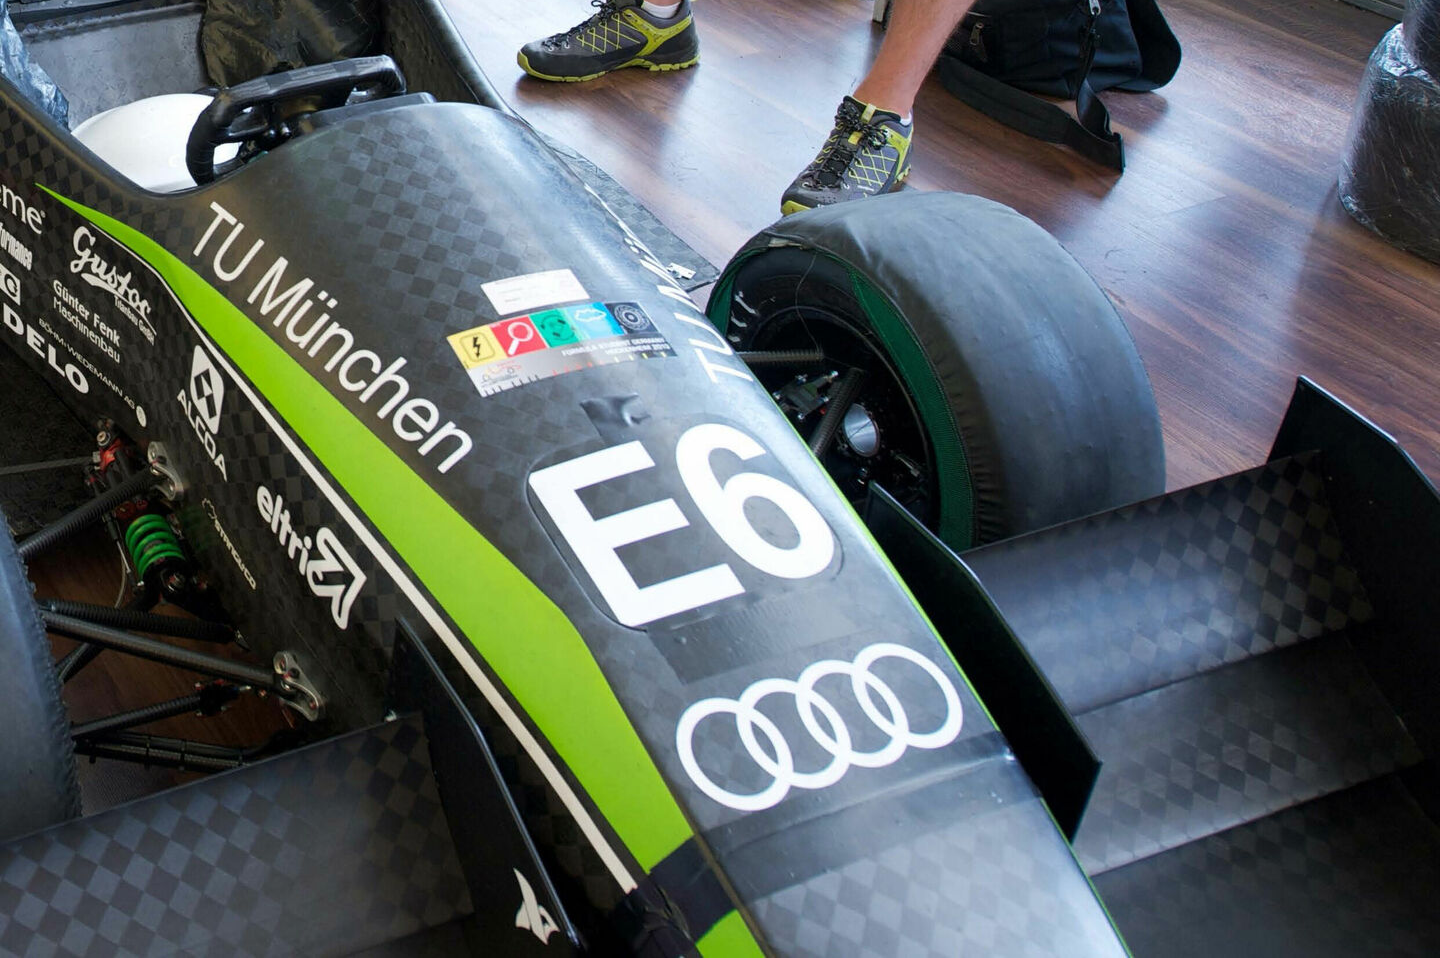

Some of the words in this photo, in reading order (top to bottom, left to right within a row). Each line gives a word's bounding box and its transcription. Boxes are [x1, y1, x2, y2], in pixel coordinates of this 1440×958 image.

[3, 302, 90, 394] DELO
[53, 280, 90, 321] Günter
[93, 312, 121, 348] Fenk
[53, 296, 120, 363] Maschinenbau
[193, 201, 265, 282] TU
[247, 256, 473, 474] München
[176, 389, 228, 482] ALCOA
[528, 423, 835, 628] E6
